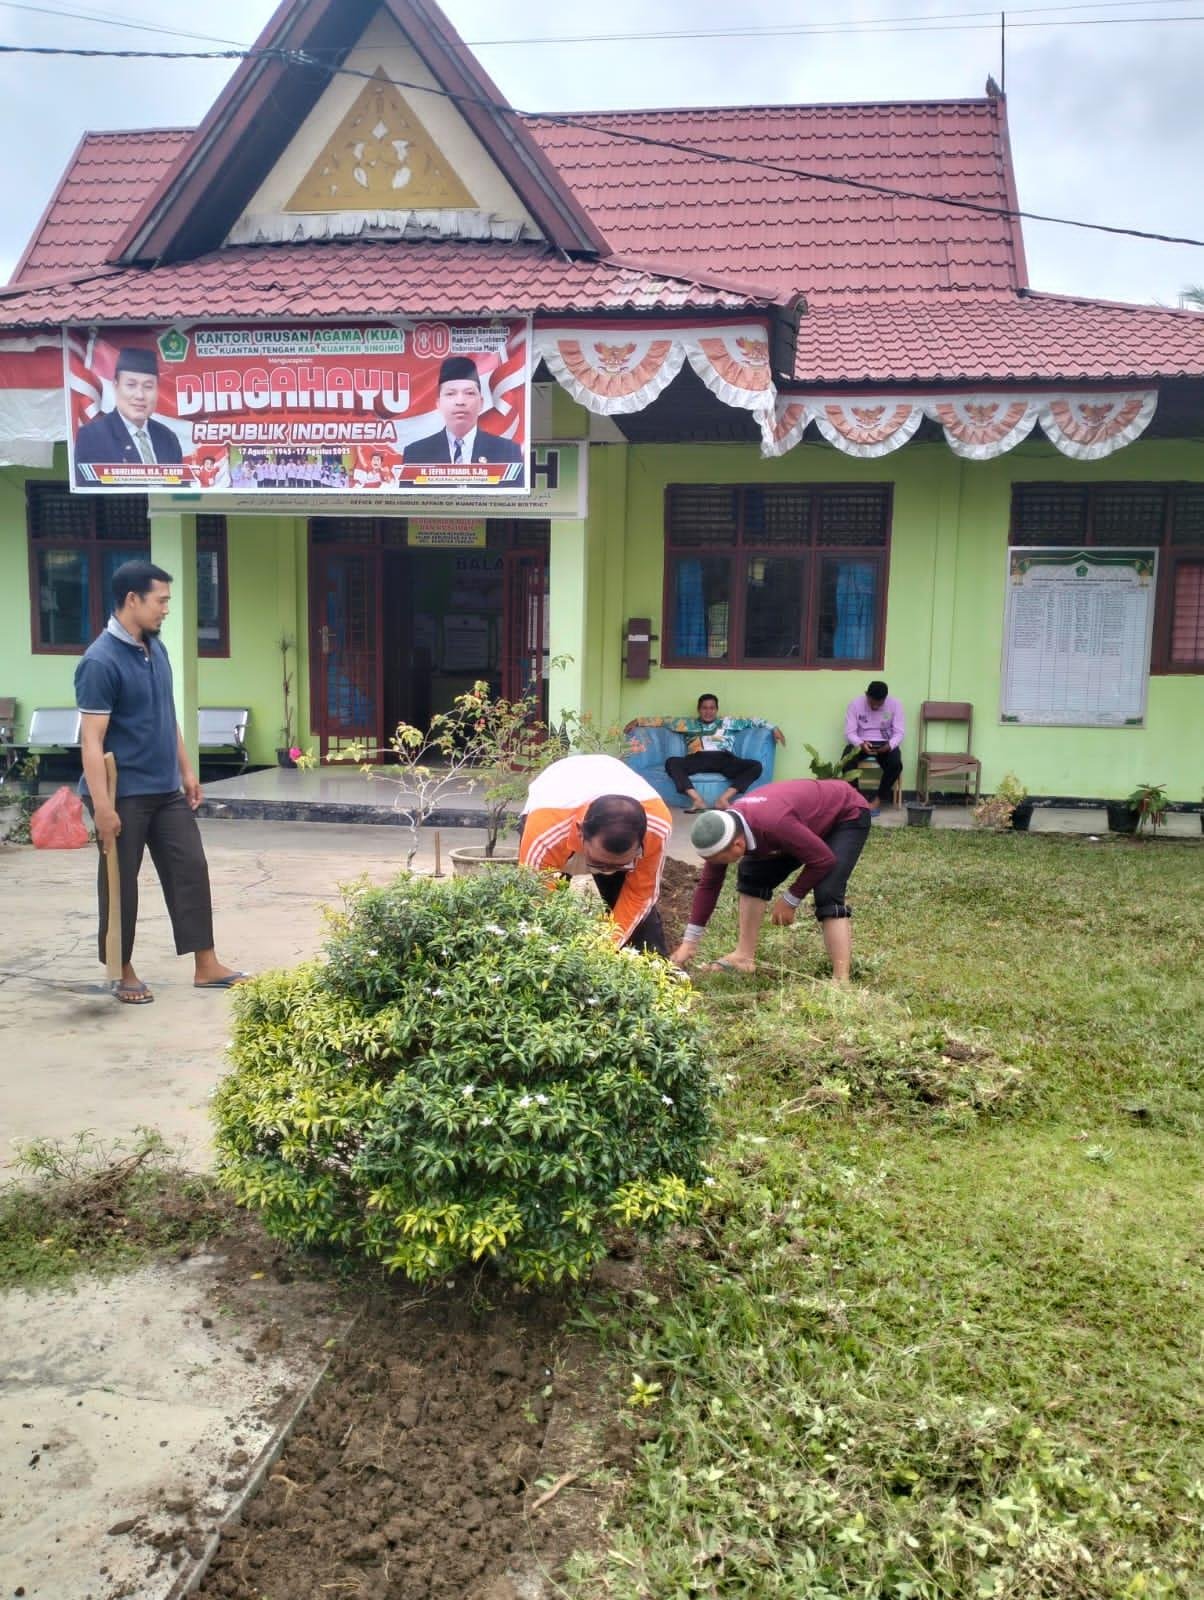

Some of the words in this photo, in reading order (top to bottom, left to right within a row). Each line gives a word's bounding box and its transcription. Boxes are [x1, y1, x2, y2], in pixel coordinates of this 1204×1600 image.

[196, 332, 254, 344] KANTOR
[256, 331, 308, 342] URUSAN
[314, 330, 361, 342] AGAMA
[365, 329, 404, 342] (KUA)
[198, 346, 217, 355] KEC.
[220, 346, 258, 354] KUANTAN
[262, 346, 296, 354] TENGAH
[298, 345, 318, 353] KAB.
[320, 344, 362, 353] KUANTAN
[176, 366, 410, 416] DIRGAHAYU
[194, 424, 290, 441] REPUBLIK
[292, 422, 396, 440] INDONESIA
[248, 448, 272, 456] Agustus
[306, 448, 332, 456] Agustus
